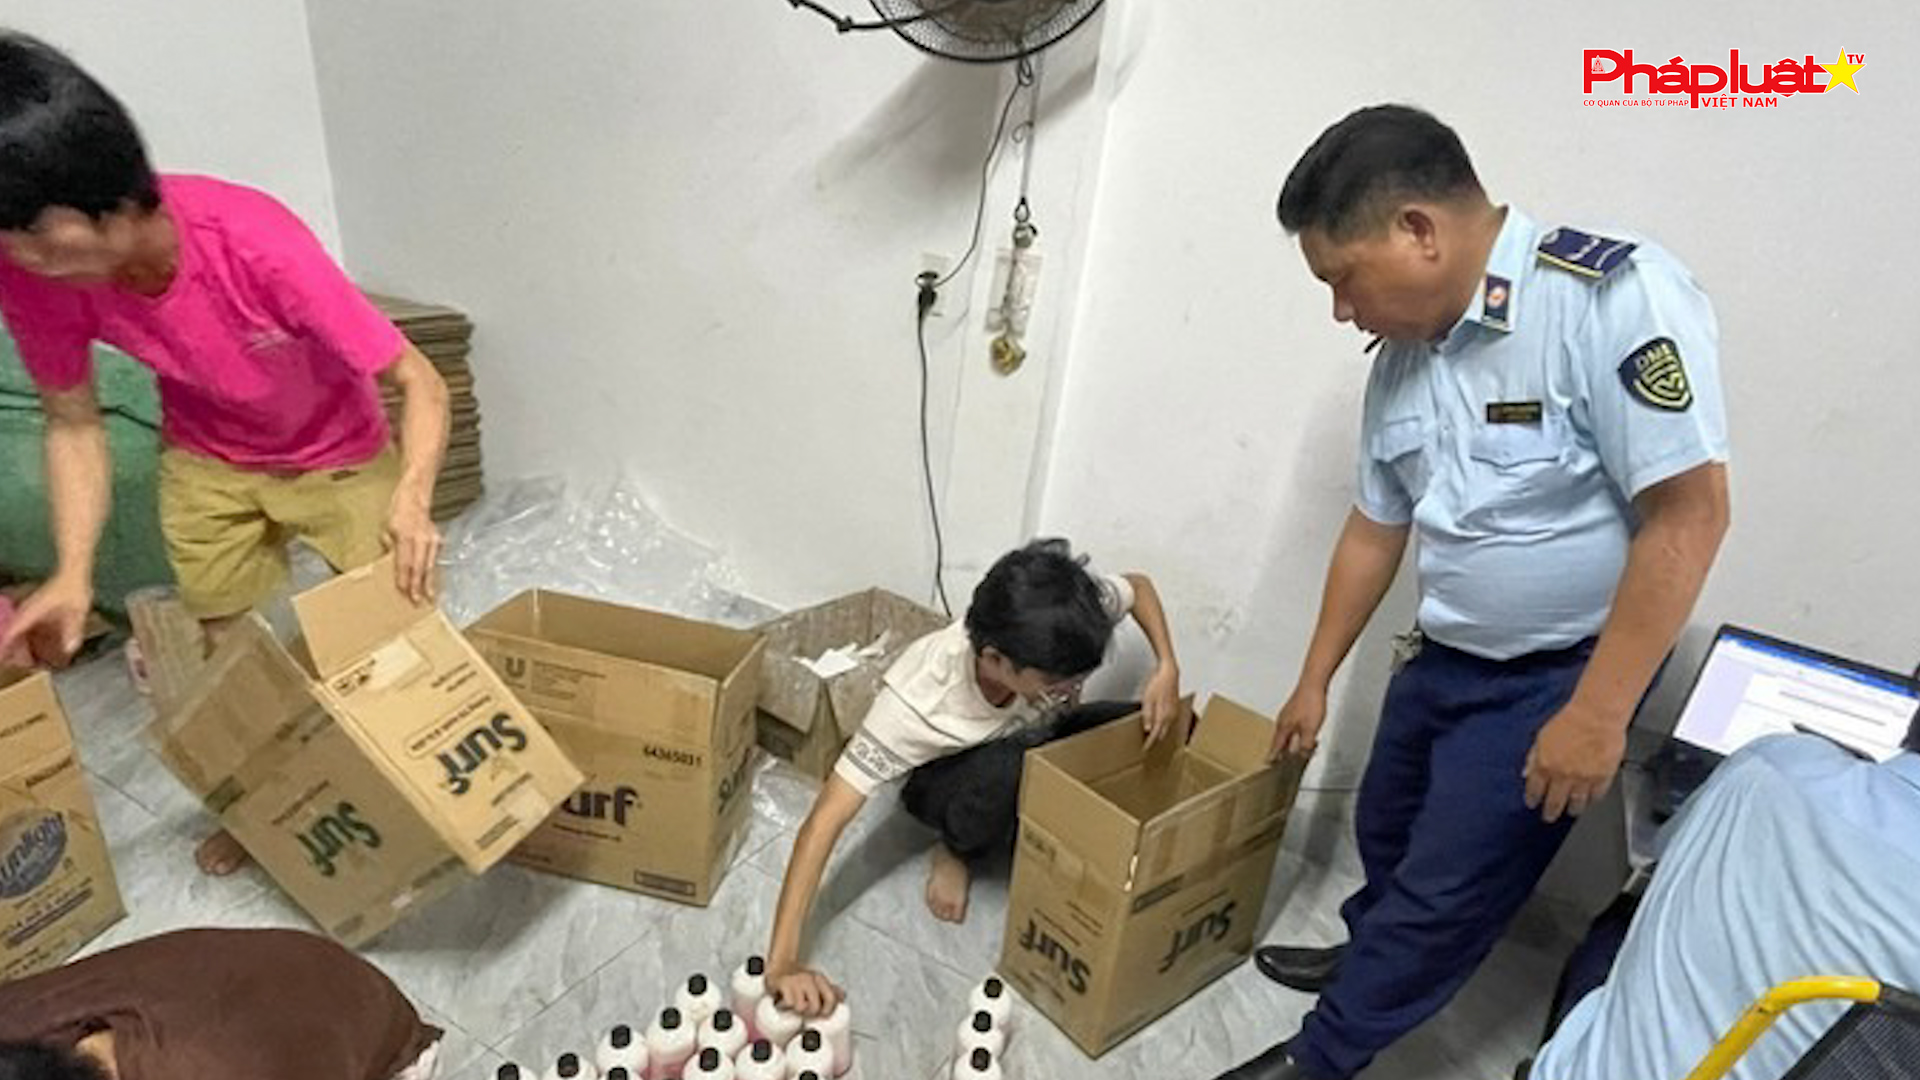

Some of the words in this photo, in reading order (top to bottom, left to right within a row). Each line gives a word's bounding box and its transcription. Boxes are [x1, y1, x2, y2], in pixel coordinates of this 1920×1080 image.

[436, 712, 528, 795] Surf
[295, 801, 383, 878] Surf
[561, 786, 639, 828] urf
[0, 811, 67, 882] unlight
[1018, 917, 1092, 996] Surf
